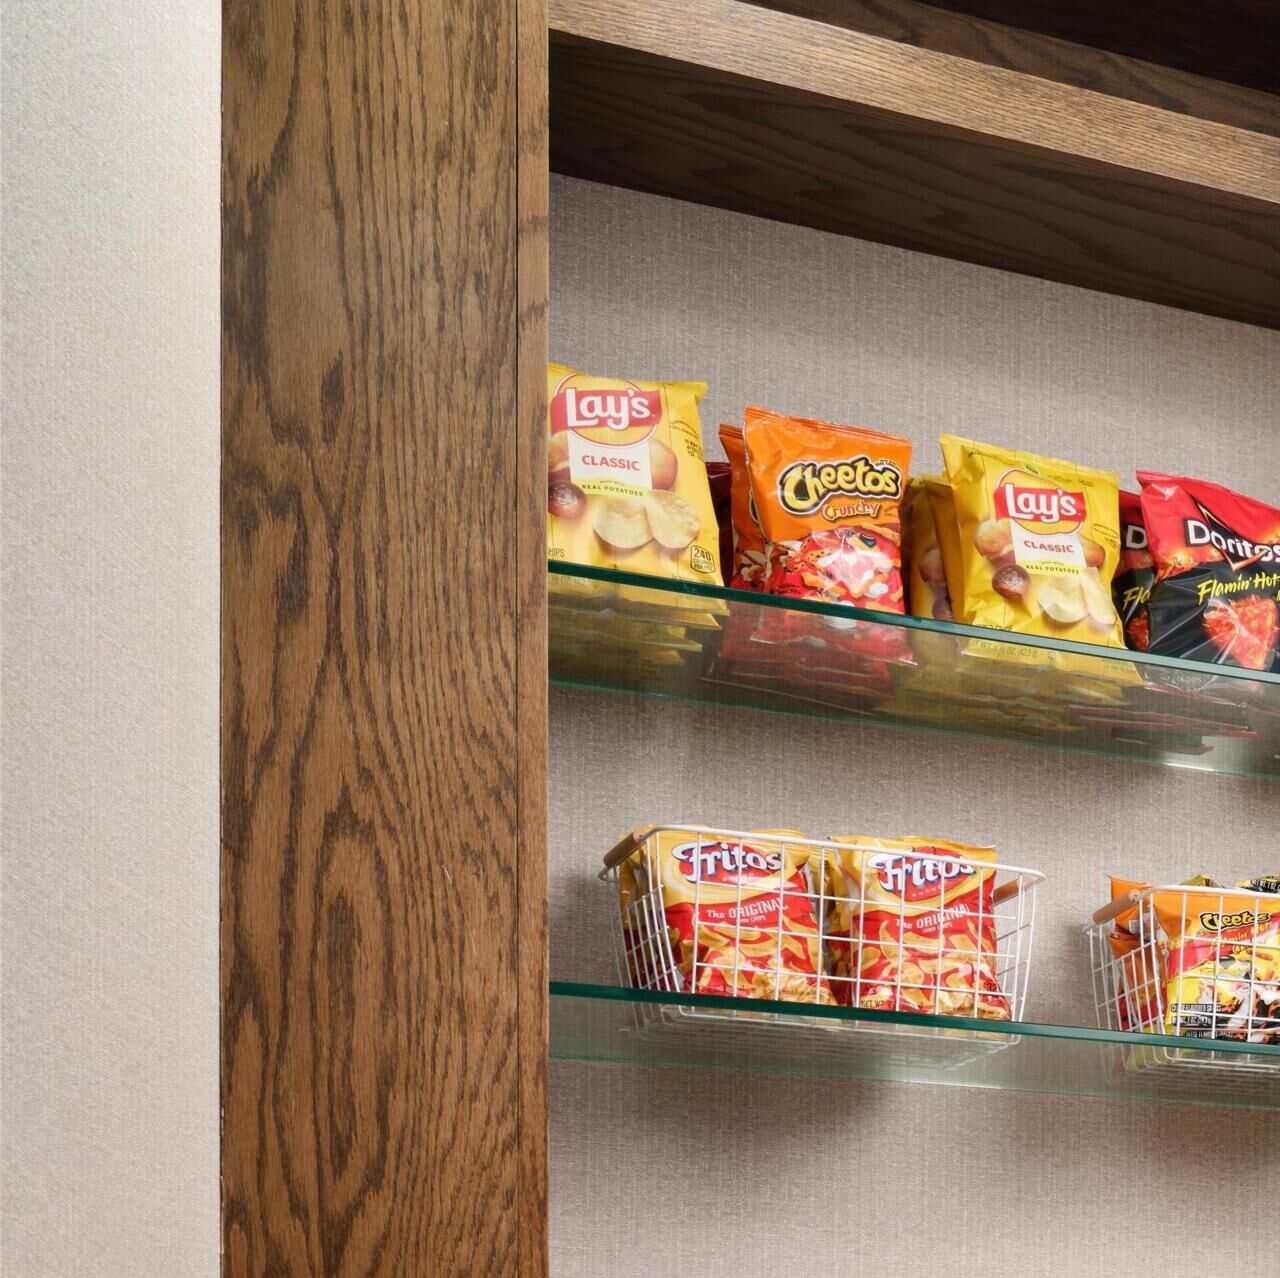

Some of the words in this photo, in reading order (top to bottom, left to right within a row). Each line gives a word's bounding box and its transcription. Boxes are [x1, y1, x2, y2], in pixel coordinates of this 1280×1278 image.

[565, 386, 651, 430] Lay's
[581, 455, 641, 471] CLASSIC
[780, 456, 901, 515] Cheetos
[1004, 483, 1078, 523] Lay's
[822, 500, 880, 522] Crunchy
[1024, 540, 1075, 554] CLASSIC
[672, 841, 782, 884] Fritos
[868, 854, 976, 893] Fritos
[706, 909, 725, 919] The
